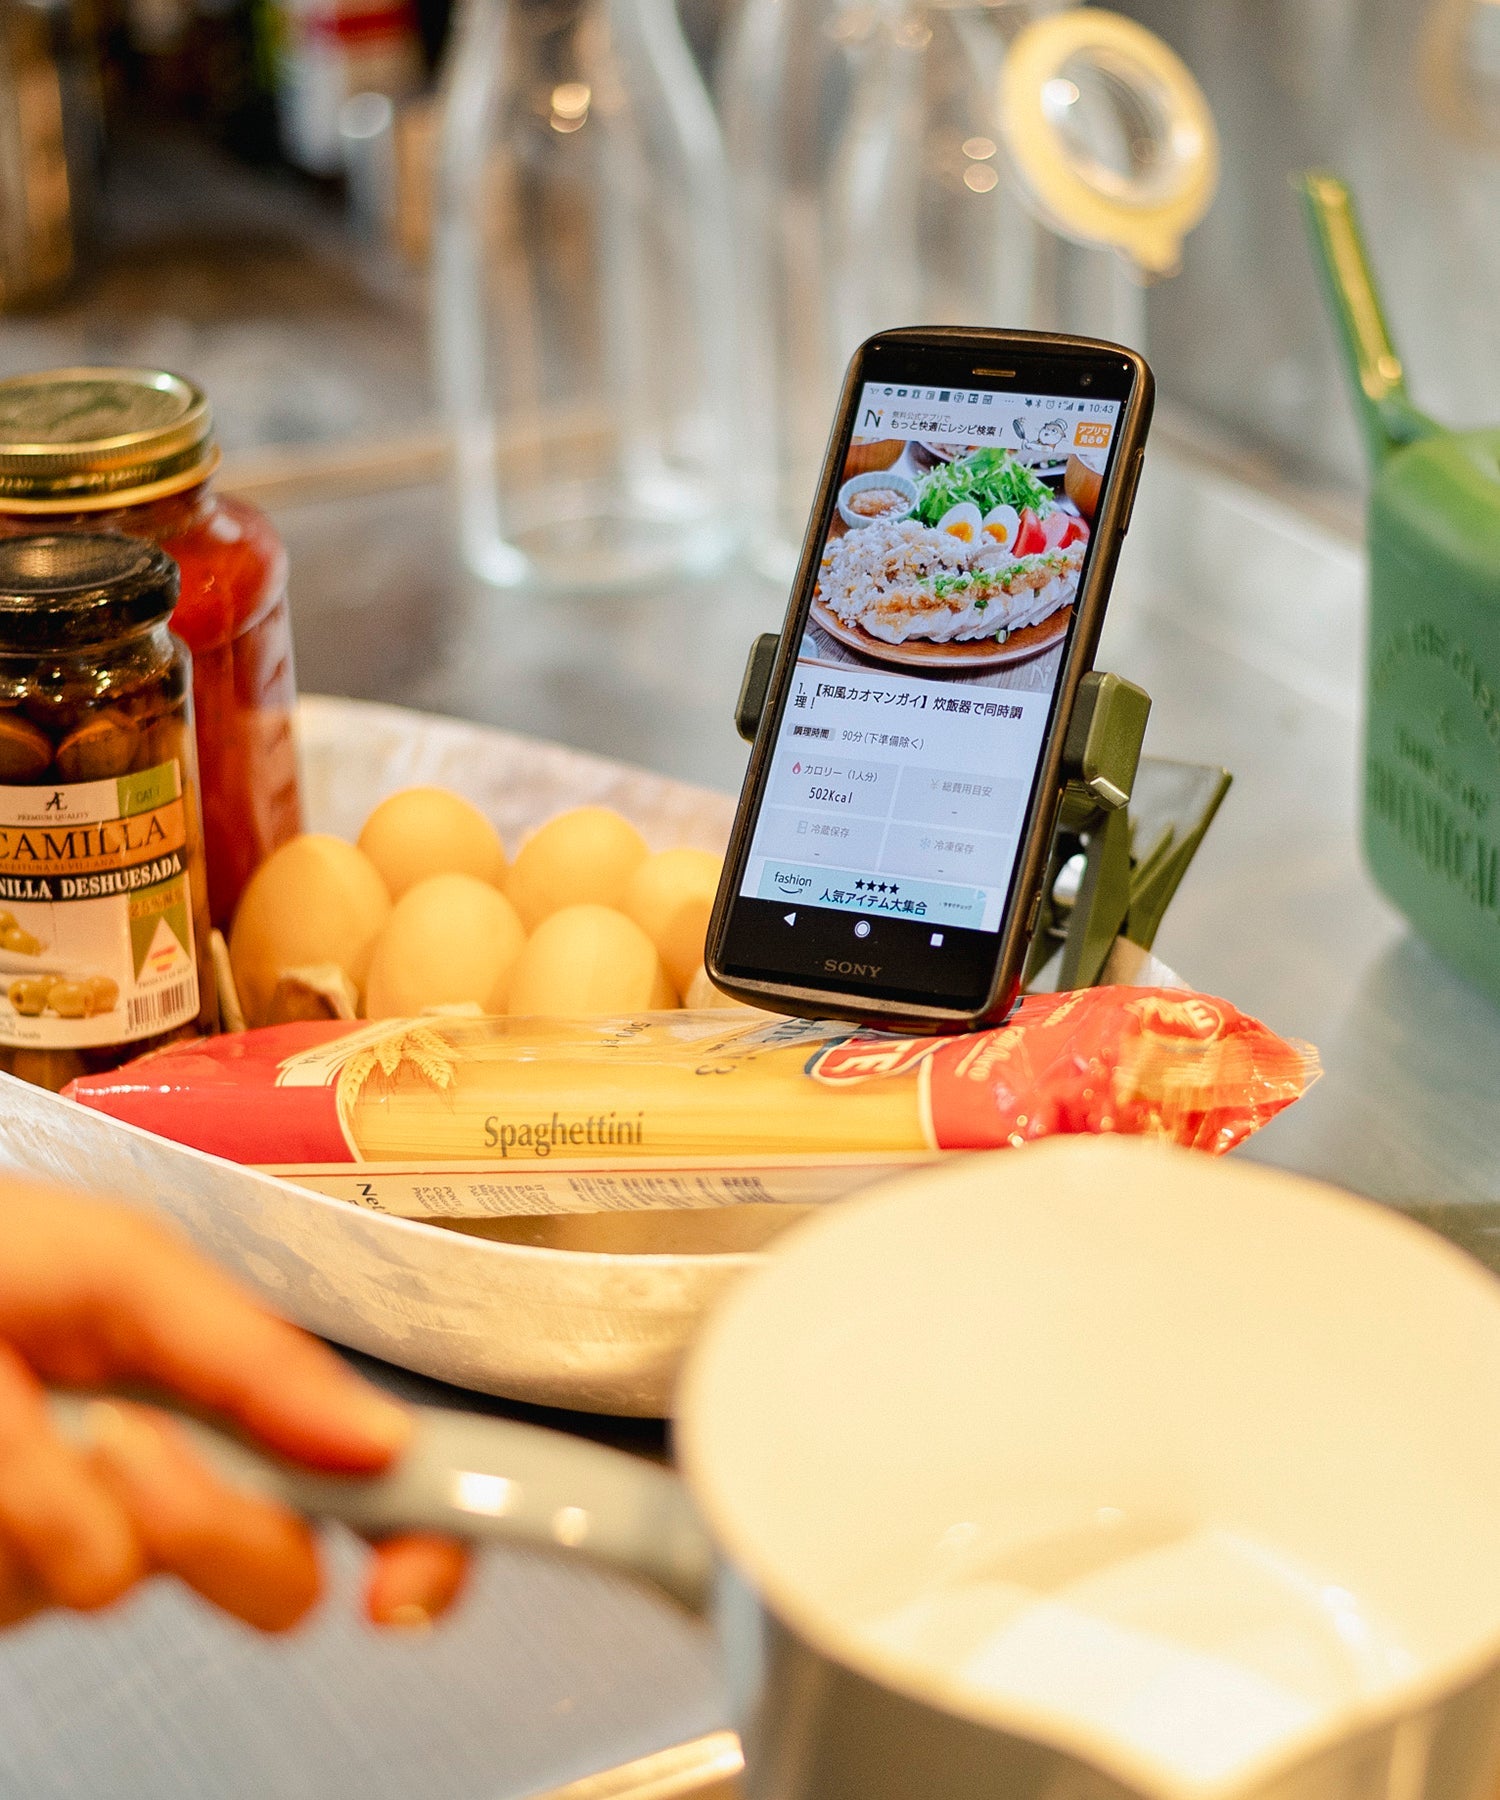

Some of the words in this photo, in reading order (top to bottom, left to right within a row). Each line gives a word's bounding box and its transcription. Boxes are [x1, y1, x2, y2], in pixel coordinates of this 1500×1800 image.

[1090, 404, 1114, 414] 10:43
[793, 725, 830, 739] 調理時間
[808, 787, 853, 804] 502Kcal
[18, 813, 52, 821] PREMIUM
[810, 823, 850, 839] 冷蔵保存
[61, 853, 182, 898] DESHUESADA
[774, 871, 812, 887] fashion
[819, 888, 928, 916] 人気アイテム大集合
[824, 959, 883, 978] SONY
[484, 1112, 644, 1156] Spaghettini
